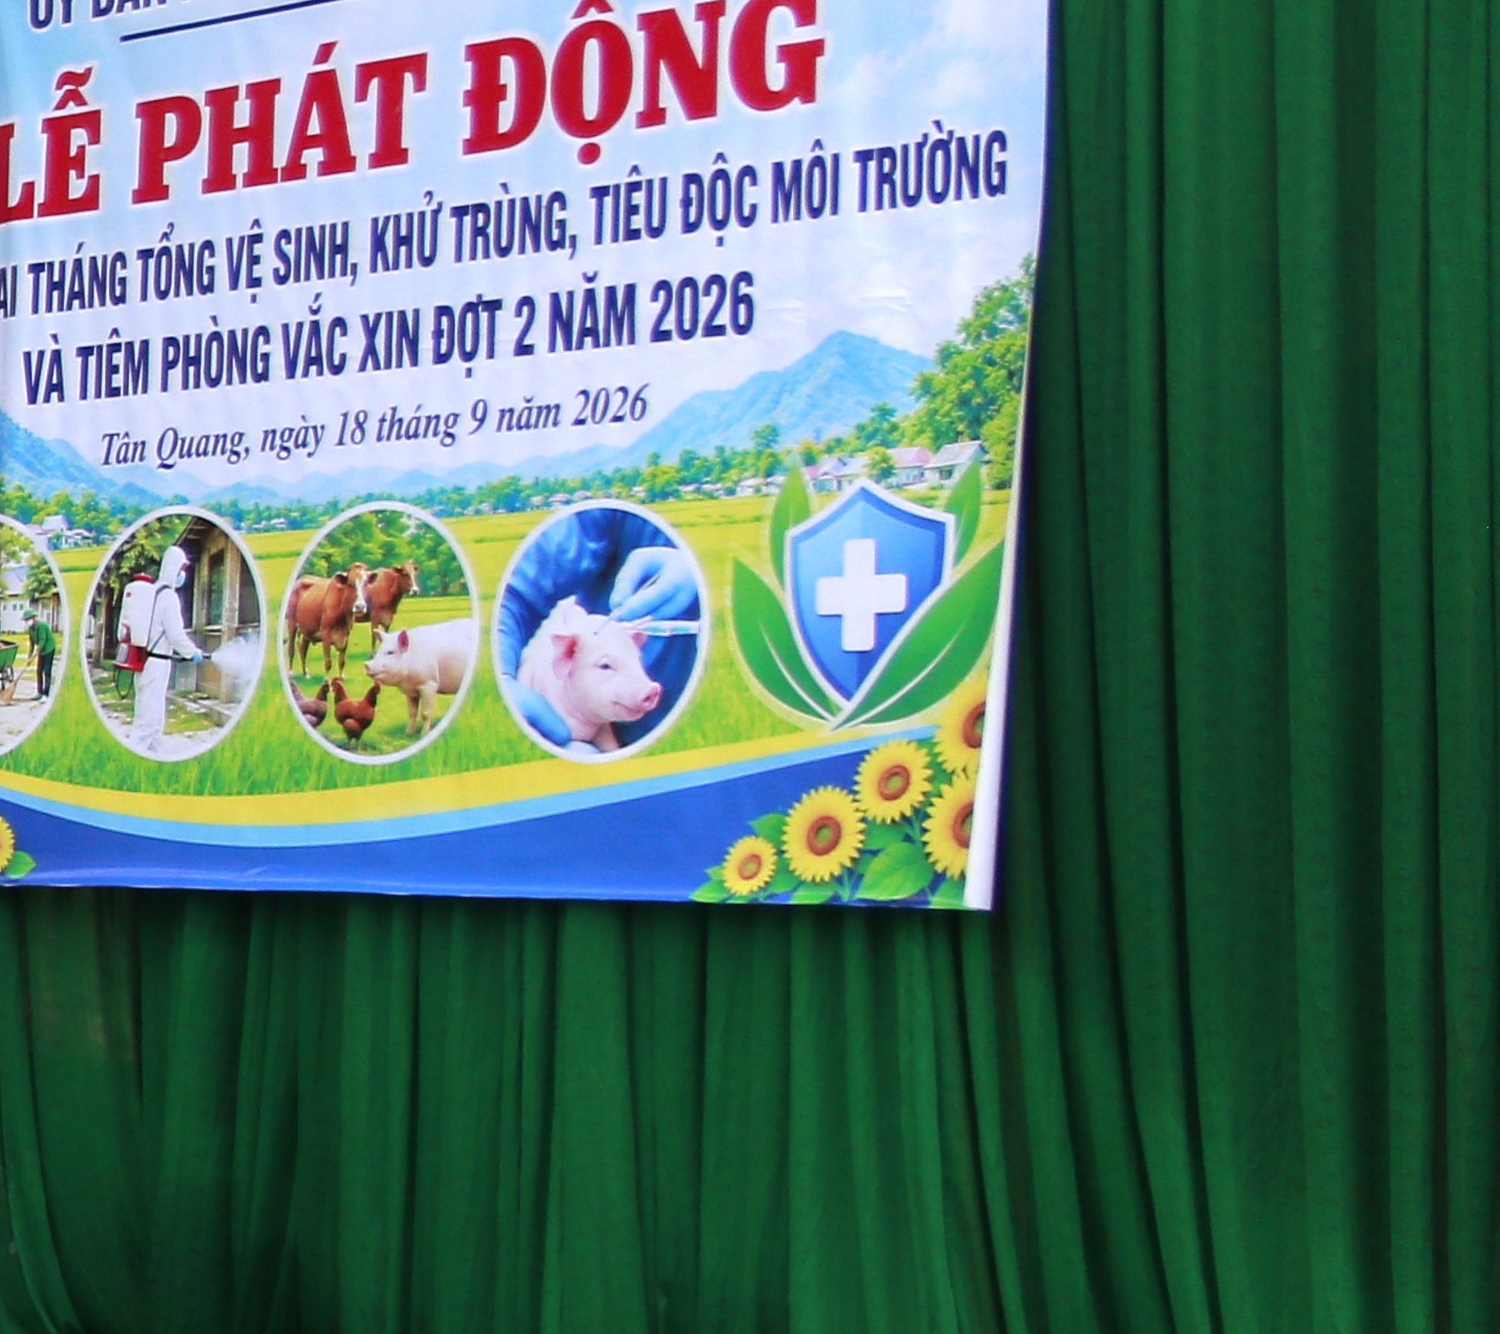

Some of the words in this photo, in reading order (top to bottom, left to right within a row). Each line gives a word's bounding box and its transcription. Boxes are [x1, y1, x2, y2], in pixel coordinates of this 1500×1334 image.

[132, 42, 427, 204] PHÁT
[28, 242, 127, 314] THÁNG
[137, 223, 215, 301] TỔNG
[226, 219, 263, 303] VỆ
[273, 222, 357, 285] SINH,
[371, 191, 442, 273] KHỬ
[451, 183, 576, 262] TRÙNG,
[591, 165, 667, 244] TIÊU
[681, 153, 757, 246] ĐỘC
[773, 139, 839, 223] MÔI
[855, 120, 1006, 212] TRƯỜNG
[24, 334, 64, 404] VÀ
[77, 328, 149, 400] TIÊM
[162, 316, 270, 392] PHÒNG
[282, 293, 347, 379] VẮC
[359, 309, 419, 372] XIN
[433, 294, 502, 377] ĐỢT
[514, 296, 535, 356] 2
[549, 272, 636, 352] NĂM
[651, 271, 753, 342] 2026
[102, 431, 146, 465] Tân
[156, 428, 250, 471] Quang,
[260, 418, 324, 460] ngày
[336, 411, 367, 445] 18
[375, 403, 461, 446] tháng
[470, 400, 488, 432] 9
[498, 393, 560, 431] năm
[572, 384, 649, 426] 2026
